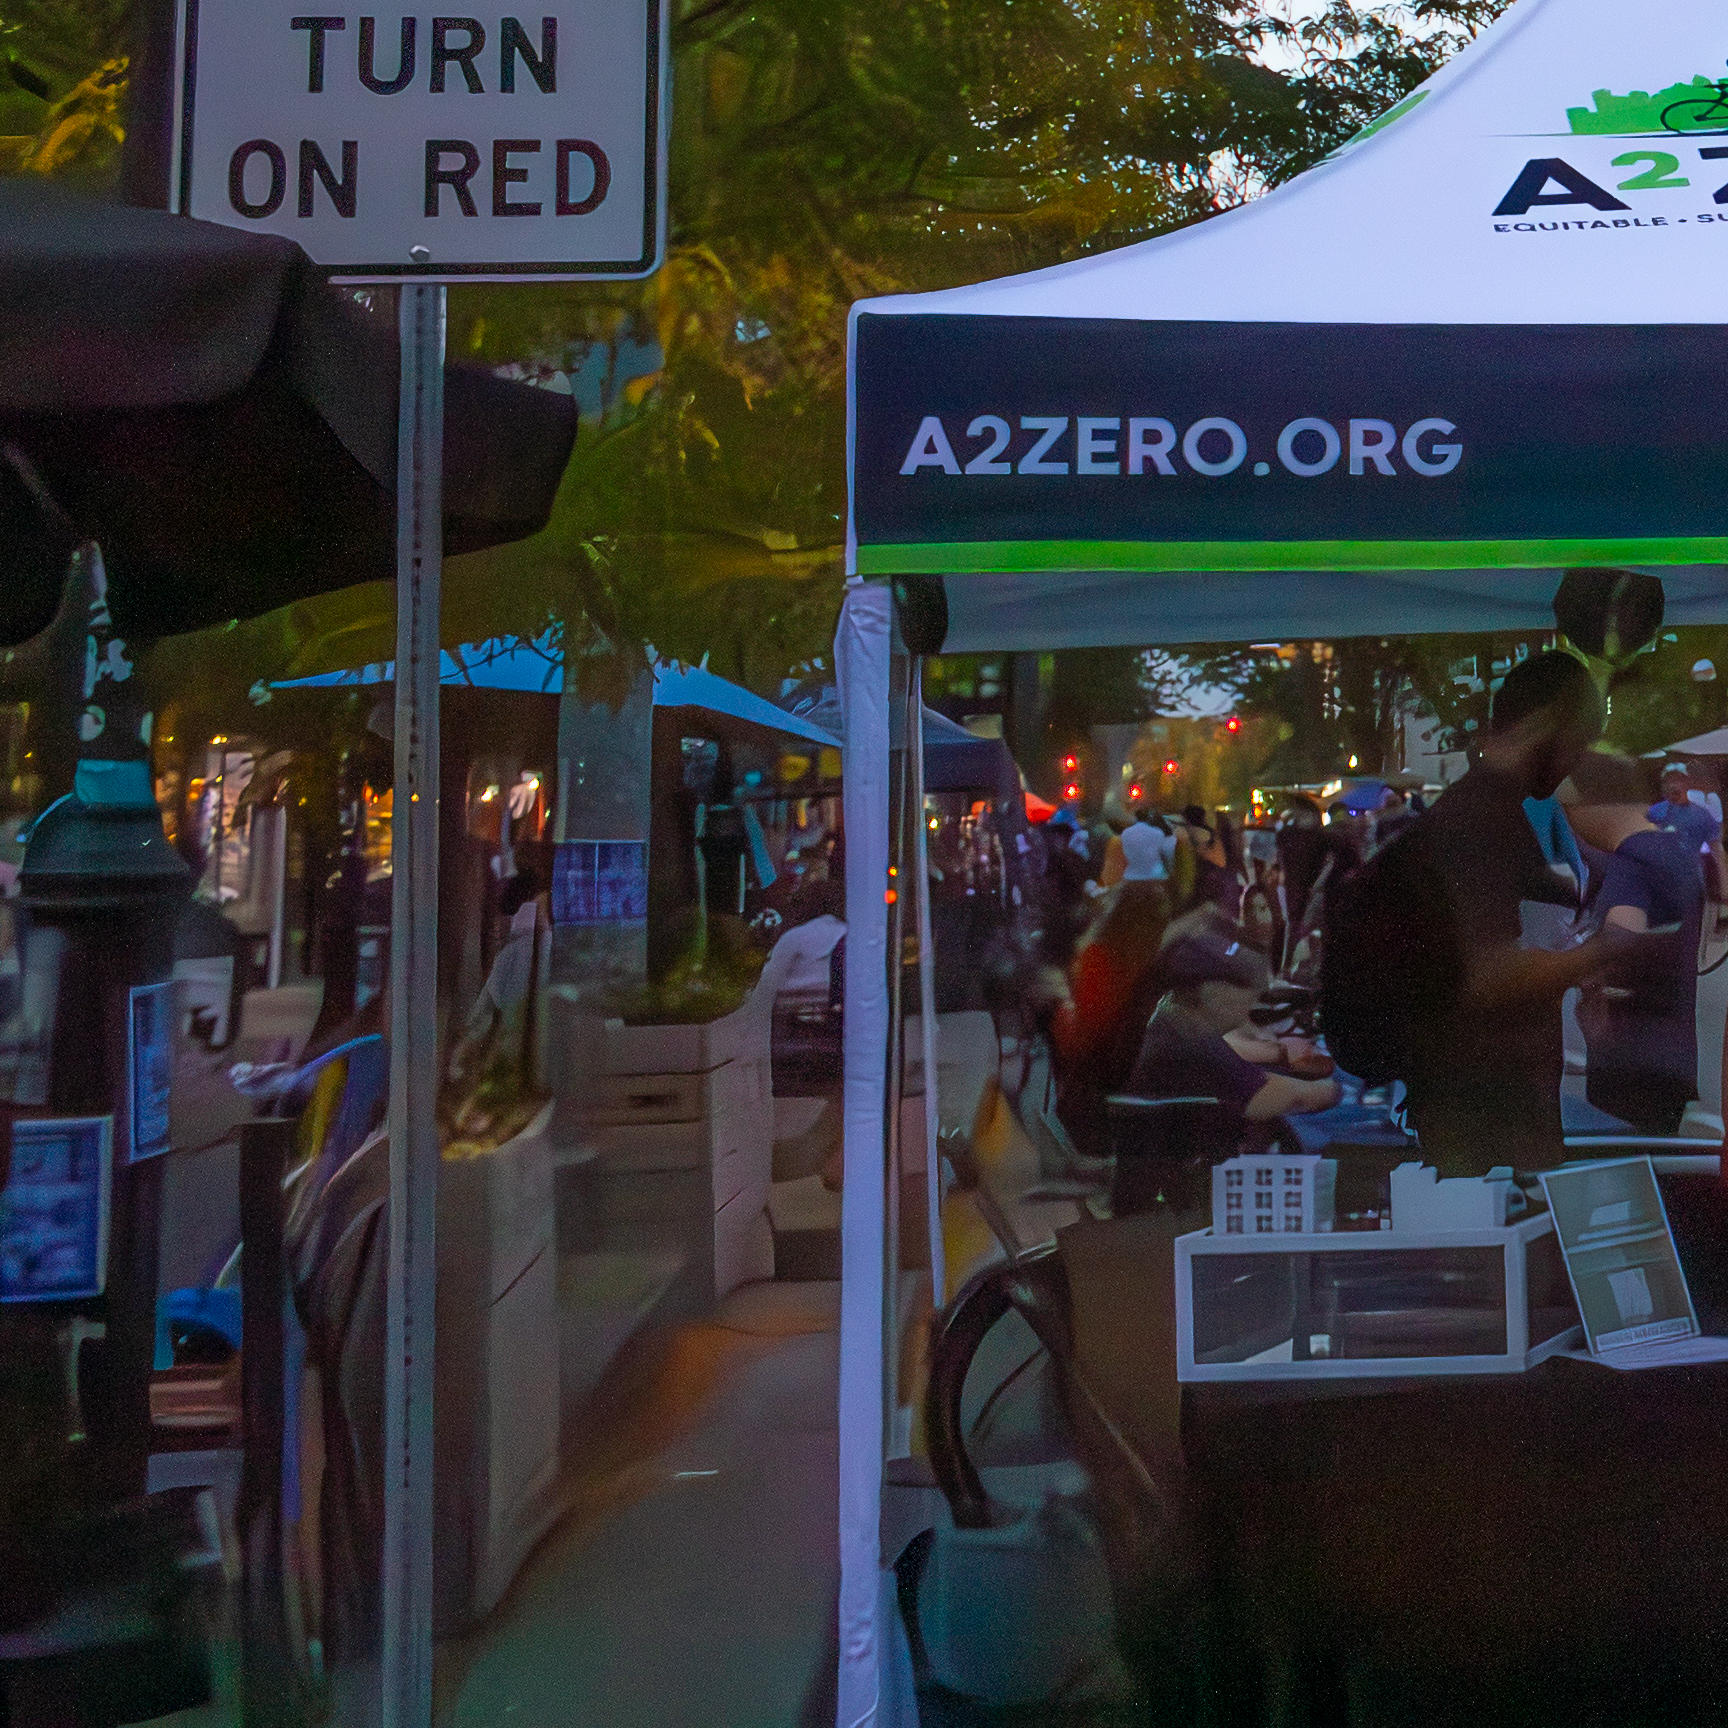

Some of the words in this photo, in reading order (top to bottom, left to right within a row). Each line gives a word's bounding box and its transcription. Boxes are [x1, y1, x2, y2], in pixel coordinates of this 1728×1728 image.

[290, 17, 558, 95] TURN
[228, 139, 358, 219] ON
[424, 139, 612, 218] RED
[1493, 217, 1666, 234] EQUITABLE
[899, 415, 1463, 477] A2ZERO.ORG
